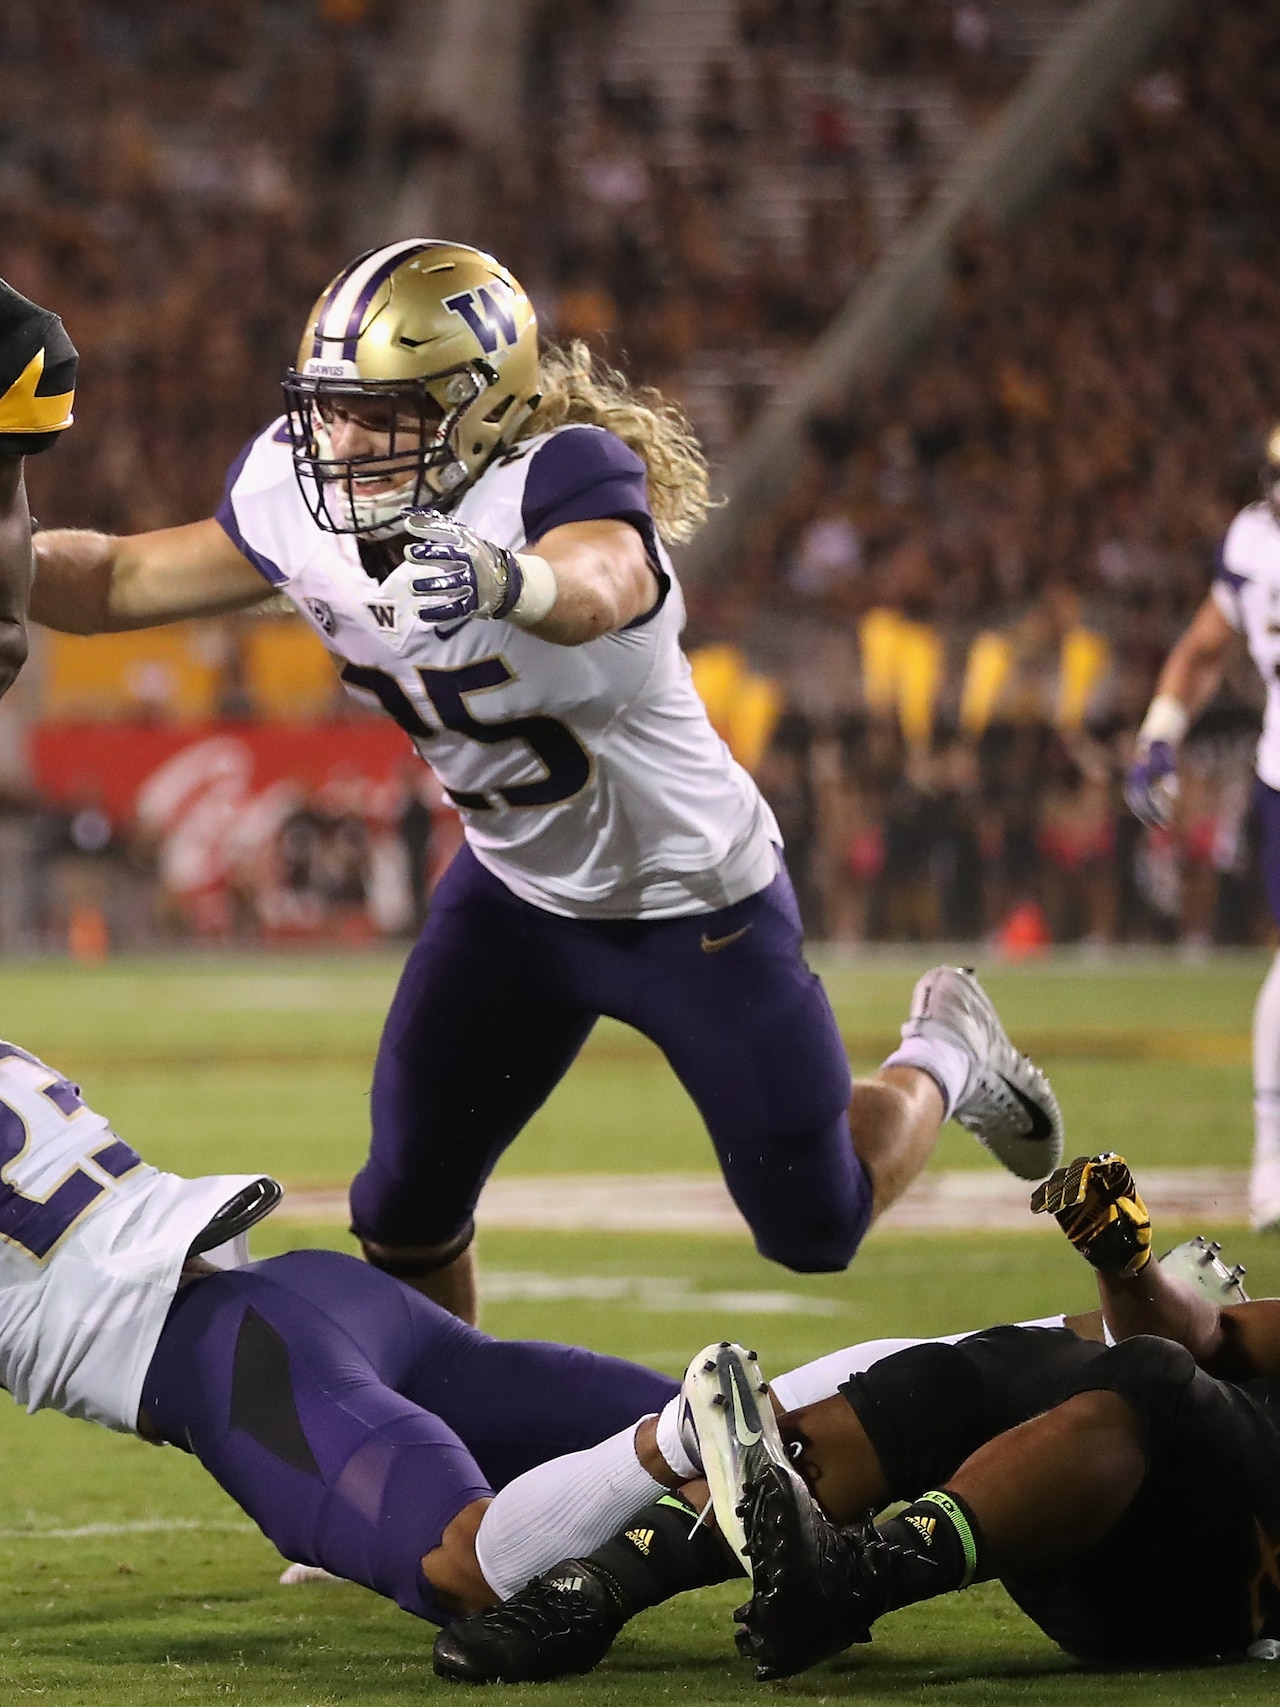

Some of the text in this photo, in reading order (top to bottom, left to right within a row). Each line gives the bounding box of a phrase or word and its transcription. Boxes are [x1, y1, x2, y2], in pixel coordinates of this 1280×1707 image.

[441, 283, 520, 356] W
[367, 604, 396, 628] W
[624, 1530, 651, 1556] adidas
[904, 1516, 933, 1547] adidas
